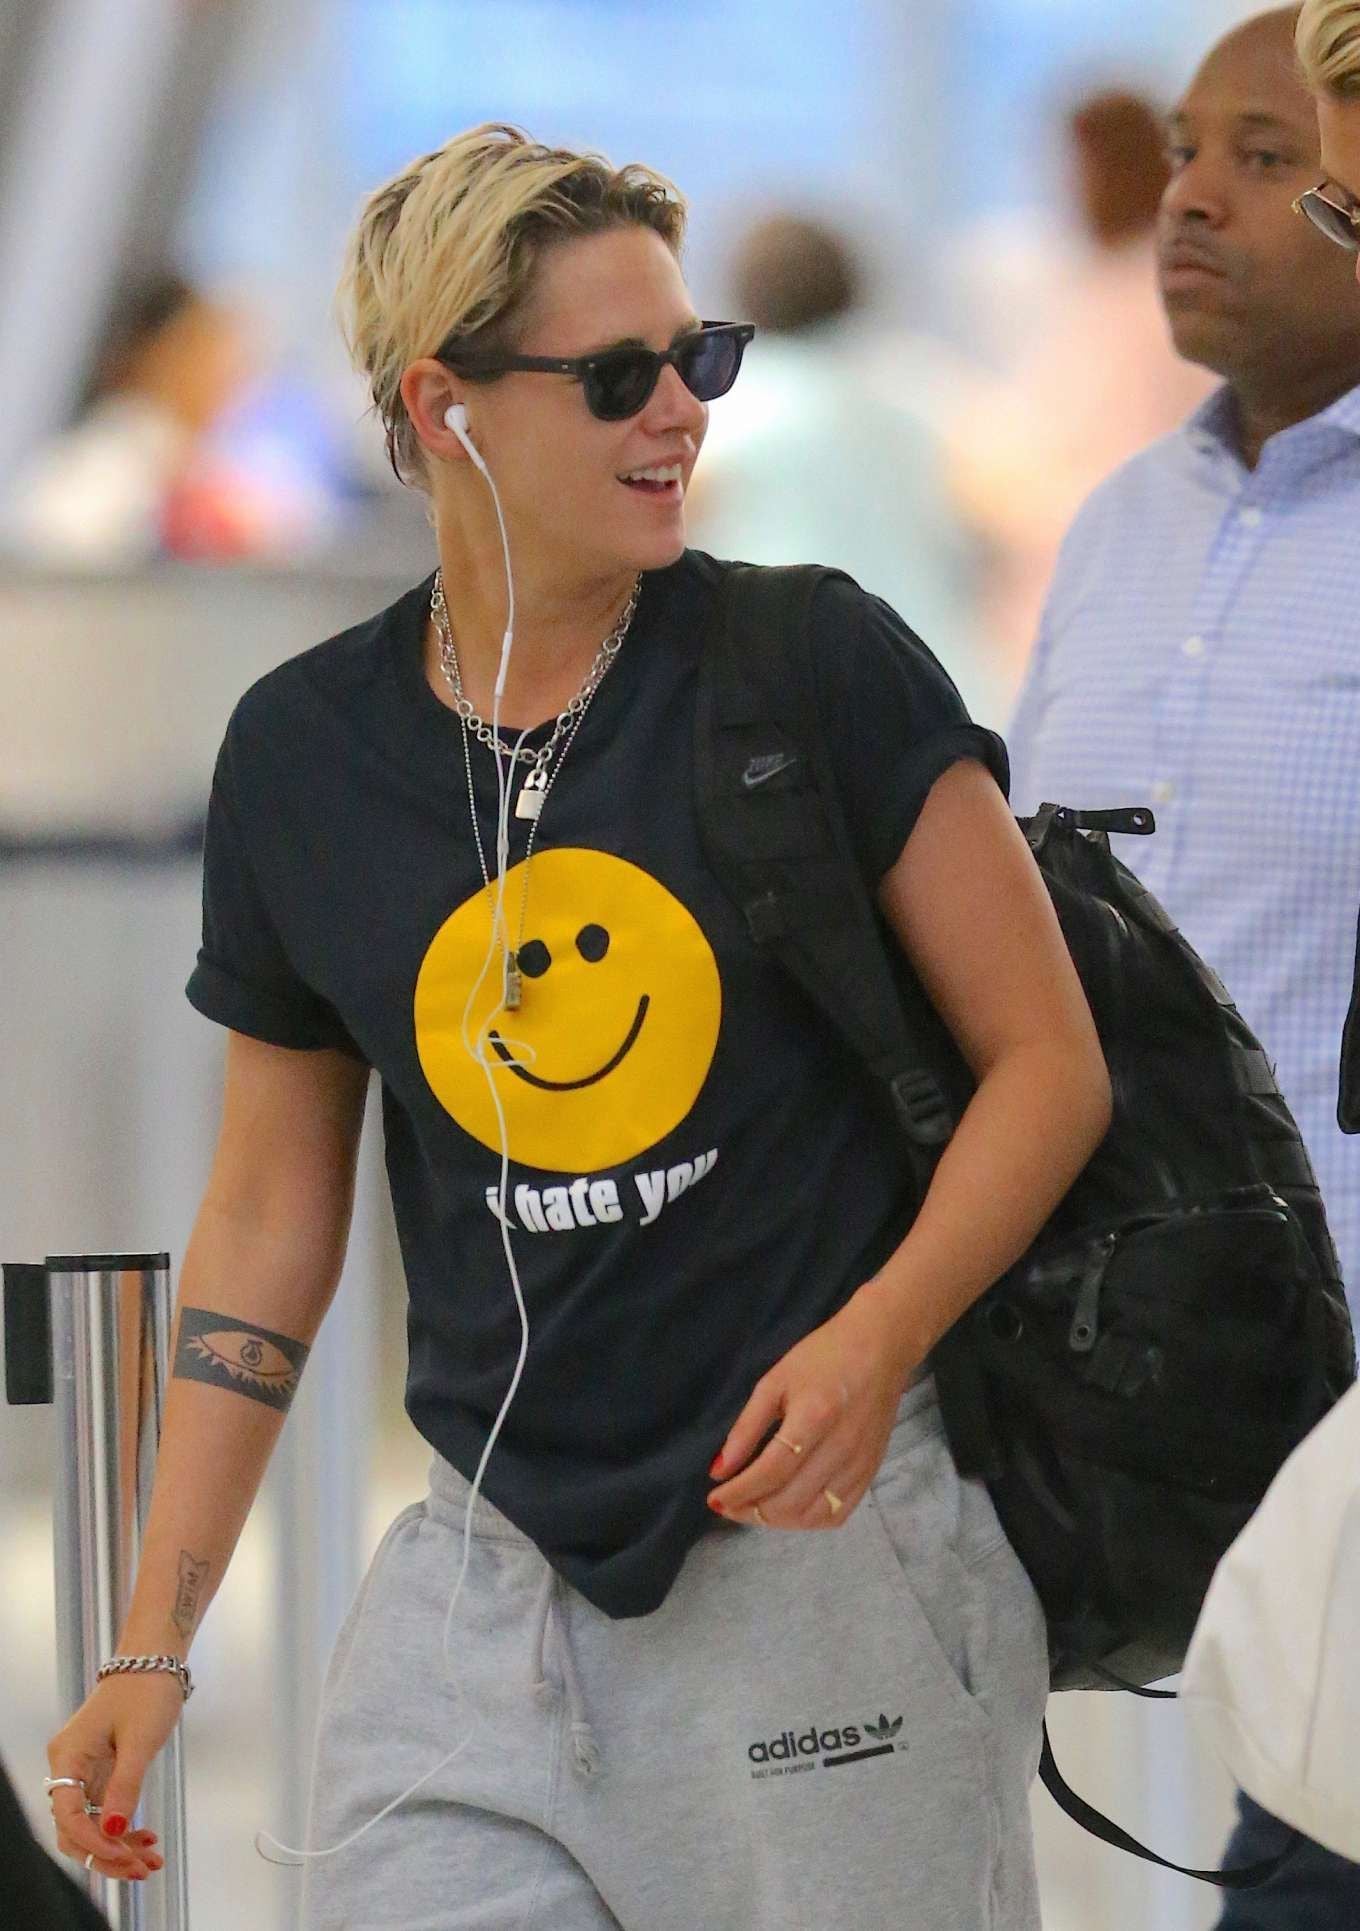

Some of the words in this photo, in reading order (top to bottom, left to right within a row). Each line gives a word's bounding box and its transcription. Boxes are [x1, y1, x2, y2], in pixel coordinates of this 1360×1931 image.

[515, 1178, 624, 1233] hate
[634, 1148, 719, 1226] you
[748, 1726, 861, 1763] adidas
